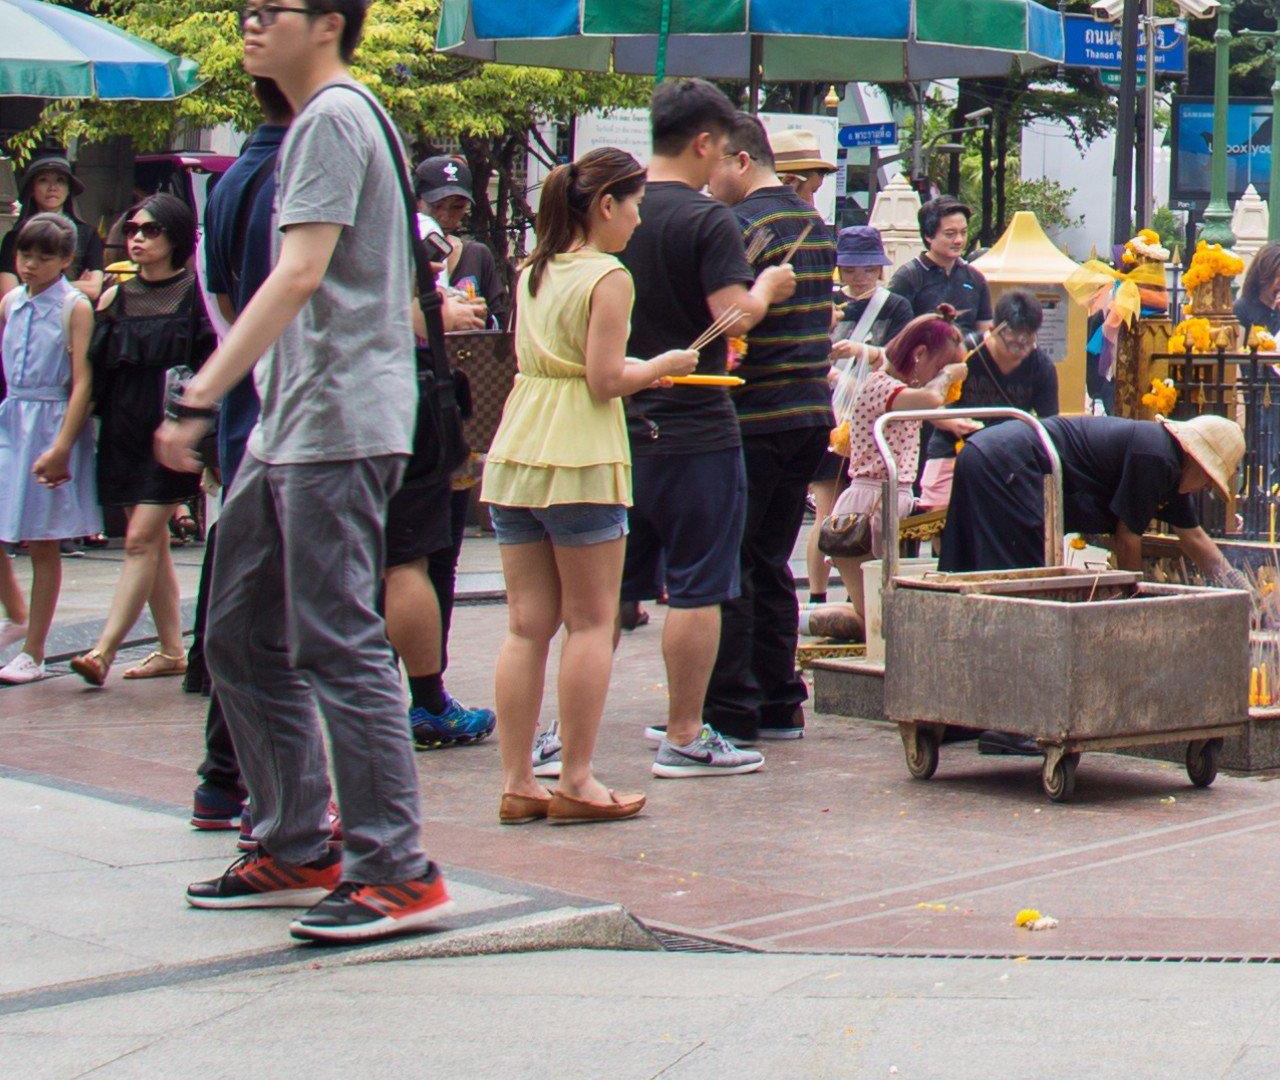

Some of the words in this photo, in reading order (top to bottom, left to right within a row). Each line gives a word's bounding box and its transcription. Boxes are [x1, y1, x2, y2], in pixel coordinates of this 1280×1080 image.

[1084, 48, 1115, 60] Thanon
[1182, 111, 1215, 119] SAMSUN
[1251, 144, 1272, 157] you
